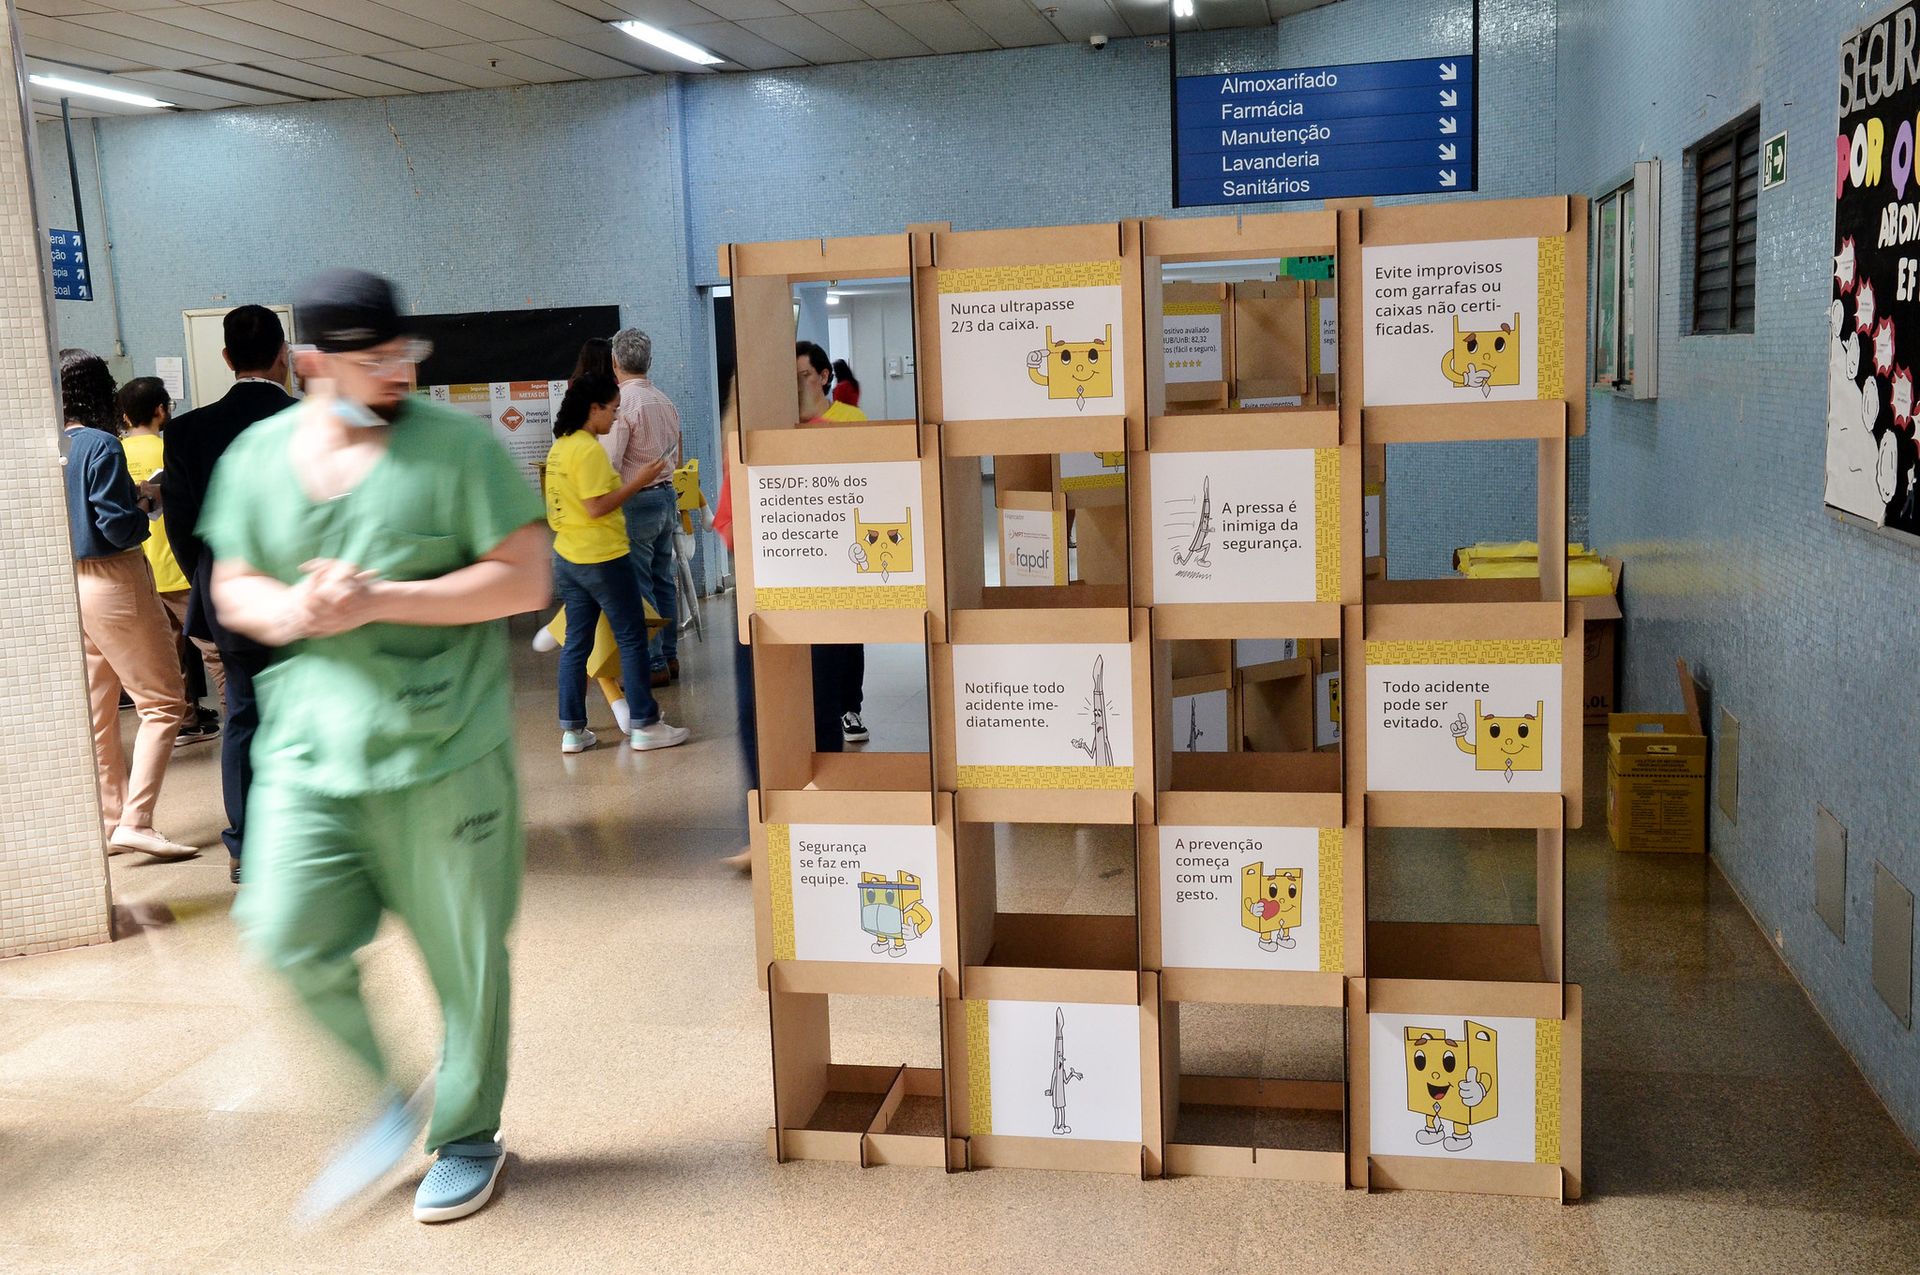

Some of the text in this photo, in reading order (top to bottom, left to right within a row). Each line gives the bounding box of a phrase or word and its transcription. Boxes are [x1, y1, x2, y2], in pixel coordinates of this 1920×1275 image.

[1220, 71, 1338, 95] Almoxarifado
[1222, 99, 1304, 119] Farmácia
[1221, 124, 1331, 145] Manutenção
[1222, 150, 1320, 171] Lavanderia
[1837, 112, 1920, 200] POR Q
[1222, 177, 1310, 196] Sanitários
[1375, 261, 1503, 279] Evite improvisos
[1897, 257, 1920, 302] EF
[1375, 280, 1501, 300] com garrafas ou
[951, 299, 1075, 315] Nunca ultrapasse
[1375, 298, 1501, 317] caixas não certi-
[951, 318, 1039, 332] 2/3 da caixa.
[1375, 321, 1434, 335] ficadas.
[758, 474, 868, 489] SES/DF: 80% dos
[759, 492, 865, 506] acidentes estão
[761, 509, 846, 523] relacionados
[1221, 500, 1297, 517] A pressa é
[1222, 518, 1298, 534] inimiga da
[761, 528, 839, 540] ao descarte
[762, 546, 828, 557] incorreto.
[1222, 539, 1302, 552] segurança.
[965, 681, 1065, 696] Notifique todo
[1382, 680, 1490, 692] Todo acidente
[965, 698, 1058, 710] acidente ime-
[1383, 698, 1449, 713] pode ser
[965, 715, 1049, 727] diatamente.
[1383, 716, 1443, 728] evitado.
[798, 840, 867, 855] Segurança
[1175, 838, 1263, 853] A prevenção
[799, 856, 861, 868] se faz em
[1175, 857, 1229, 869] começa
[800, 873, 849, 887] equipe.
[1176, 874, 1233, 883] com um
[1175, 890, 1218, 902] gesto.
